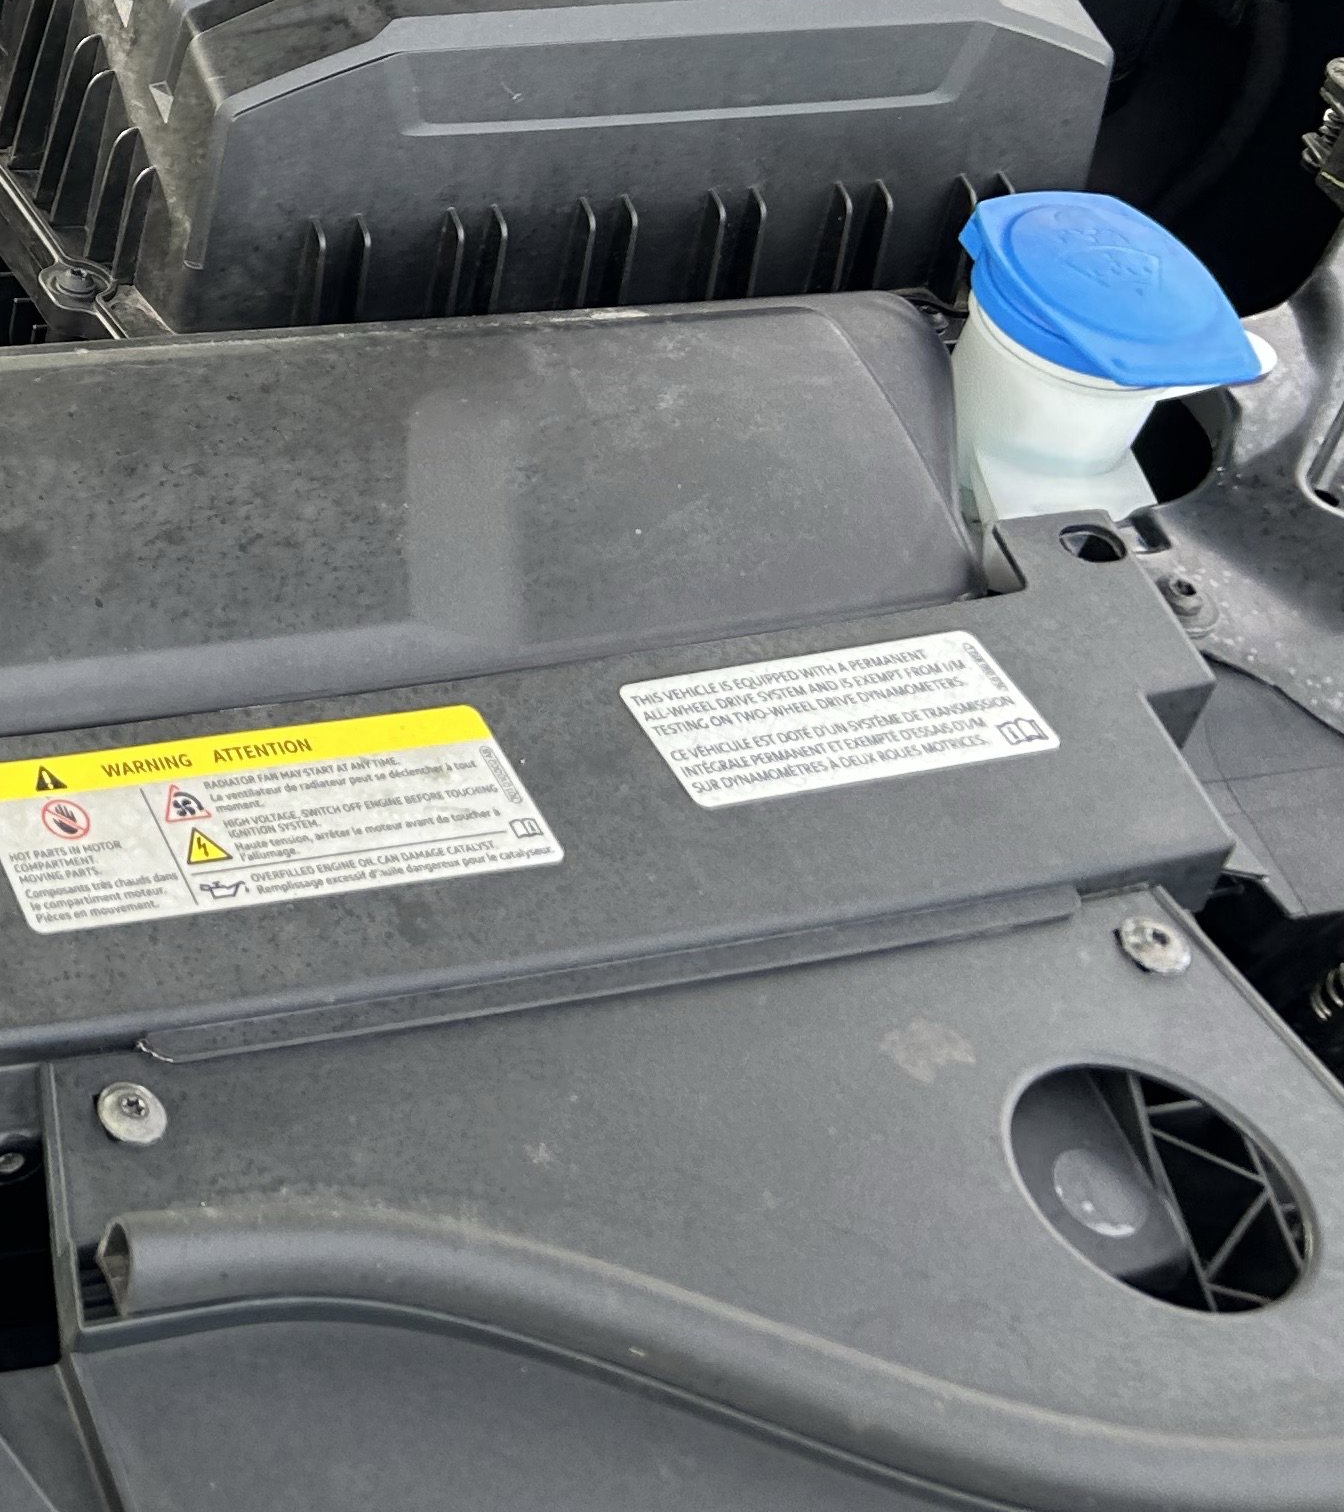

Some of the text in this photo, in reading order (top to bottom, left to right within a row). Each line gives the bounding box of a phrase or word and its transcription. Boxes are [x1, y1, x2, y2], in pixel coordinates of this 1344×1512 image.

[630, 649, 926, 706] THIS VEHICLE IS EQUIPPED WITH A PERMANENT
[643, 663, 942, 721] ALL-WHEEL DRIVE SYSTEM AND IS EXEMPT FROM
[651, 693, 857, 736] TESTING ON TWO-WHEEL DRIVE
[669, 748, 689, 761] CE
[751, 734, 776, 747] EST
[901, 710, 922, 722] DE
[920, 696, 1014, 718] TRANSMISSION
[101, 738, 311, 776] WARNING ATTENTION
[691, 744, 922, 793] SUR DEUX ROUES
[750, 742, 826, 764] PERMANENT
[826, 740, 843, 752] ET
[203, 760, 370, 789] RADIATOR FAN MAY START AT ANY
[225, 786, 281, 800] ventilateur
[283, 782, 297, 792] de
[298, 777, 346, 790] radiateur
[222, 783, 498, 828] HIGH SWITCH OFF ENGINE BEFORE TOUCHING
[227, 825, 276, 838] IGNITION
[8, 840, 122, 862] HOT PARTS IN MOTOR
[250, 865, 315, 882] OVERFILLED
[316, 859, 356, 873] ENGINE
[376, 853, 400, 864] CAN
[400, 847, 445, 861] DAMAGE
[18, 871, 63, 884] MOVING
[24, 884, 91, 899] Composants
